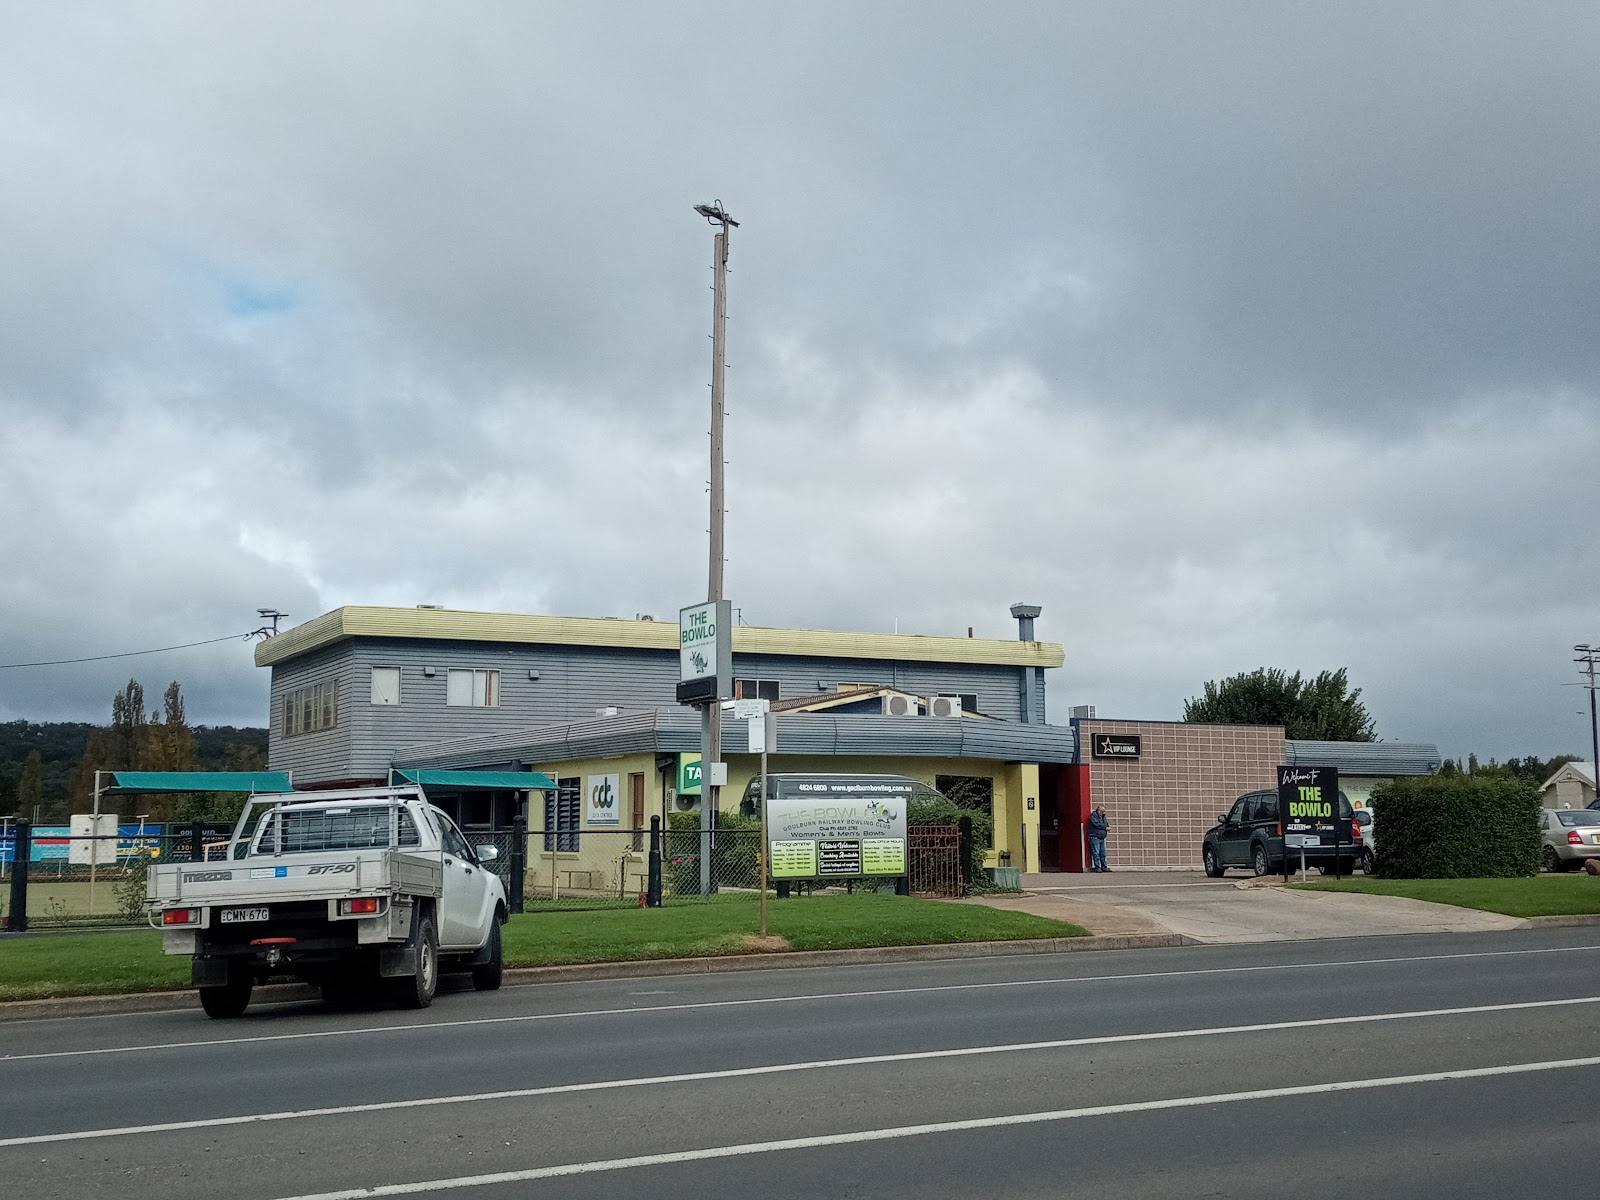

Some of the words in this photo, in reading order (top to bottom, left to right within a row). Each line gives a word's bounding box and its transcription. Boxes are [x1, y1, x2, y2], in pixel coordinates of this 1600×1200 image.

[689, 611, 707, 627] THE
[682, 624, 716, 643] BOWLO
[1282, 769, 1310, 785] Welcome
[1298, 786, 1322, 801] THE
[778, 810, 811, 823] THE
[1289, 802, 1332, 817] BOWLO
[783, 821, 816, 832] GOULBURN
[875, 822, 891, 830] CLUB
[837, 841, 859, 849] Welcome
[307, 864, 356, 875] BT-50
